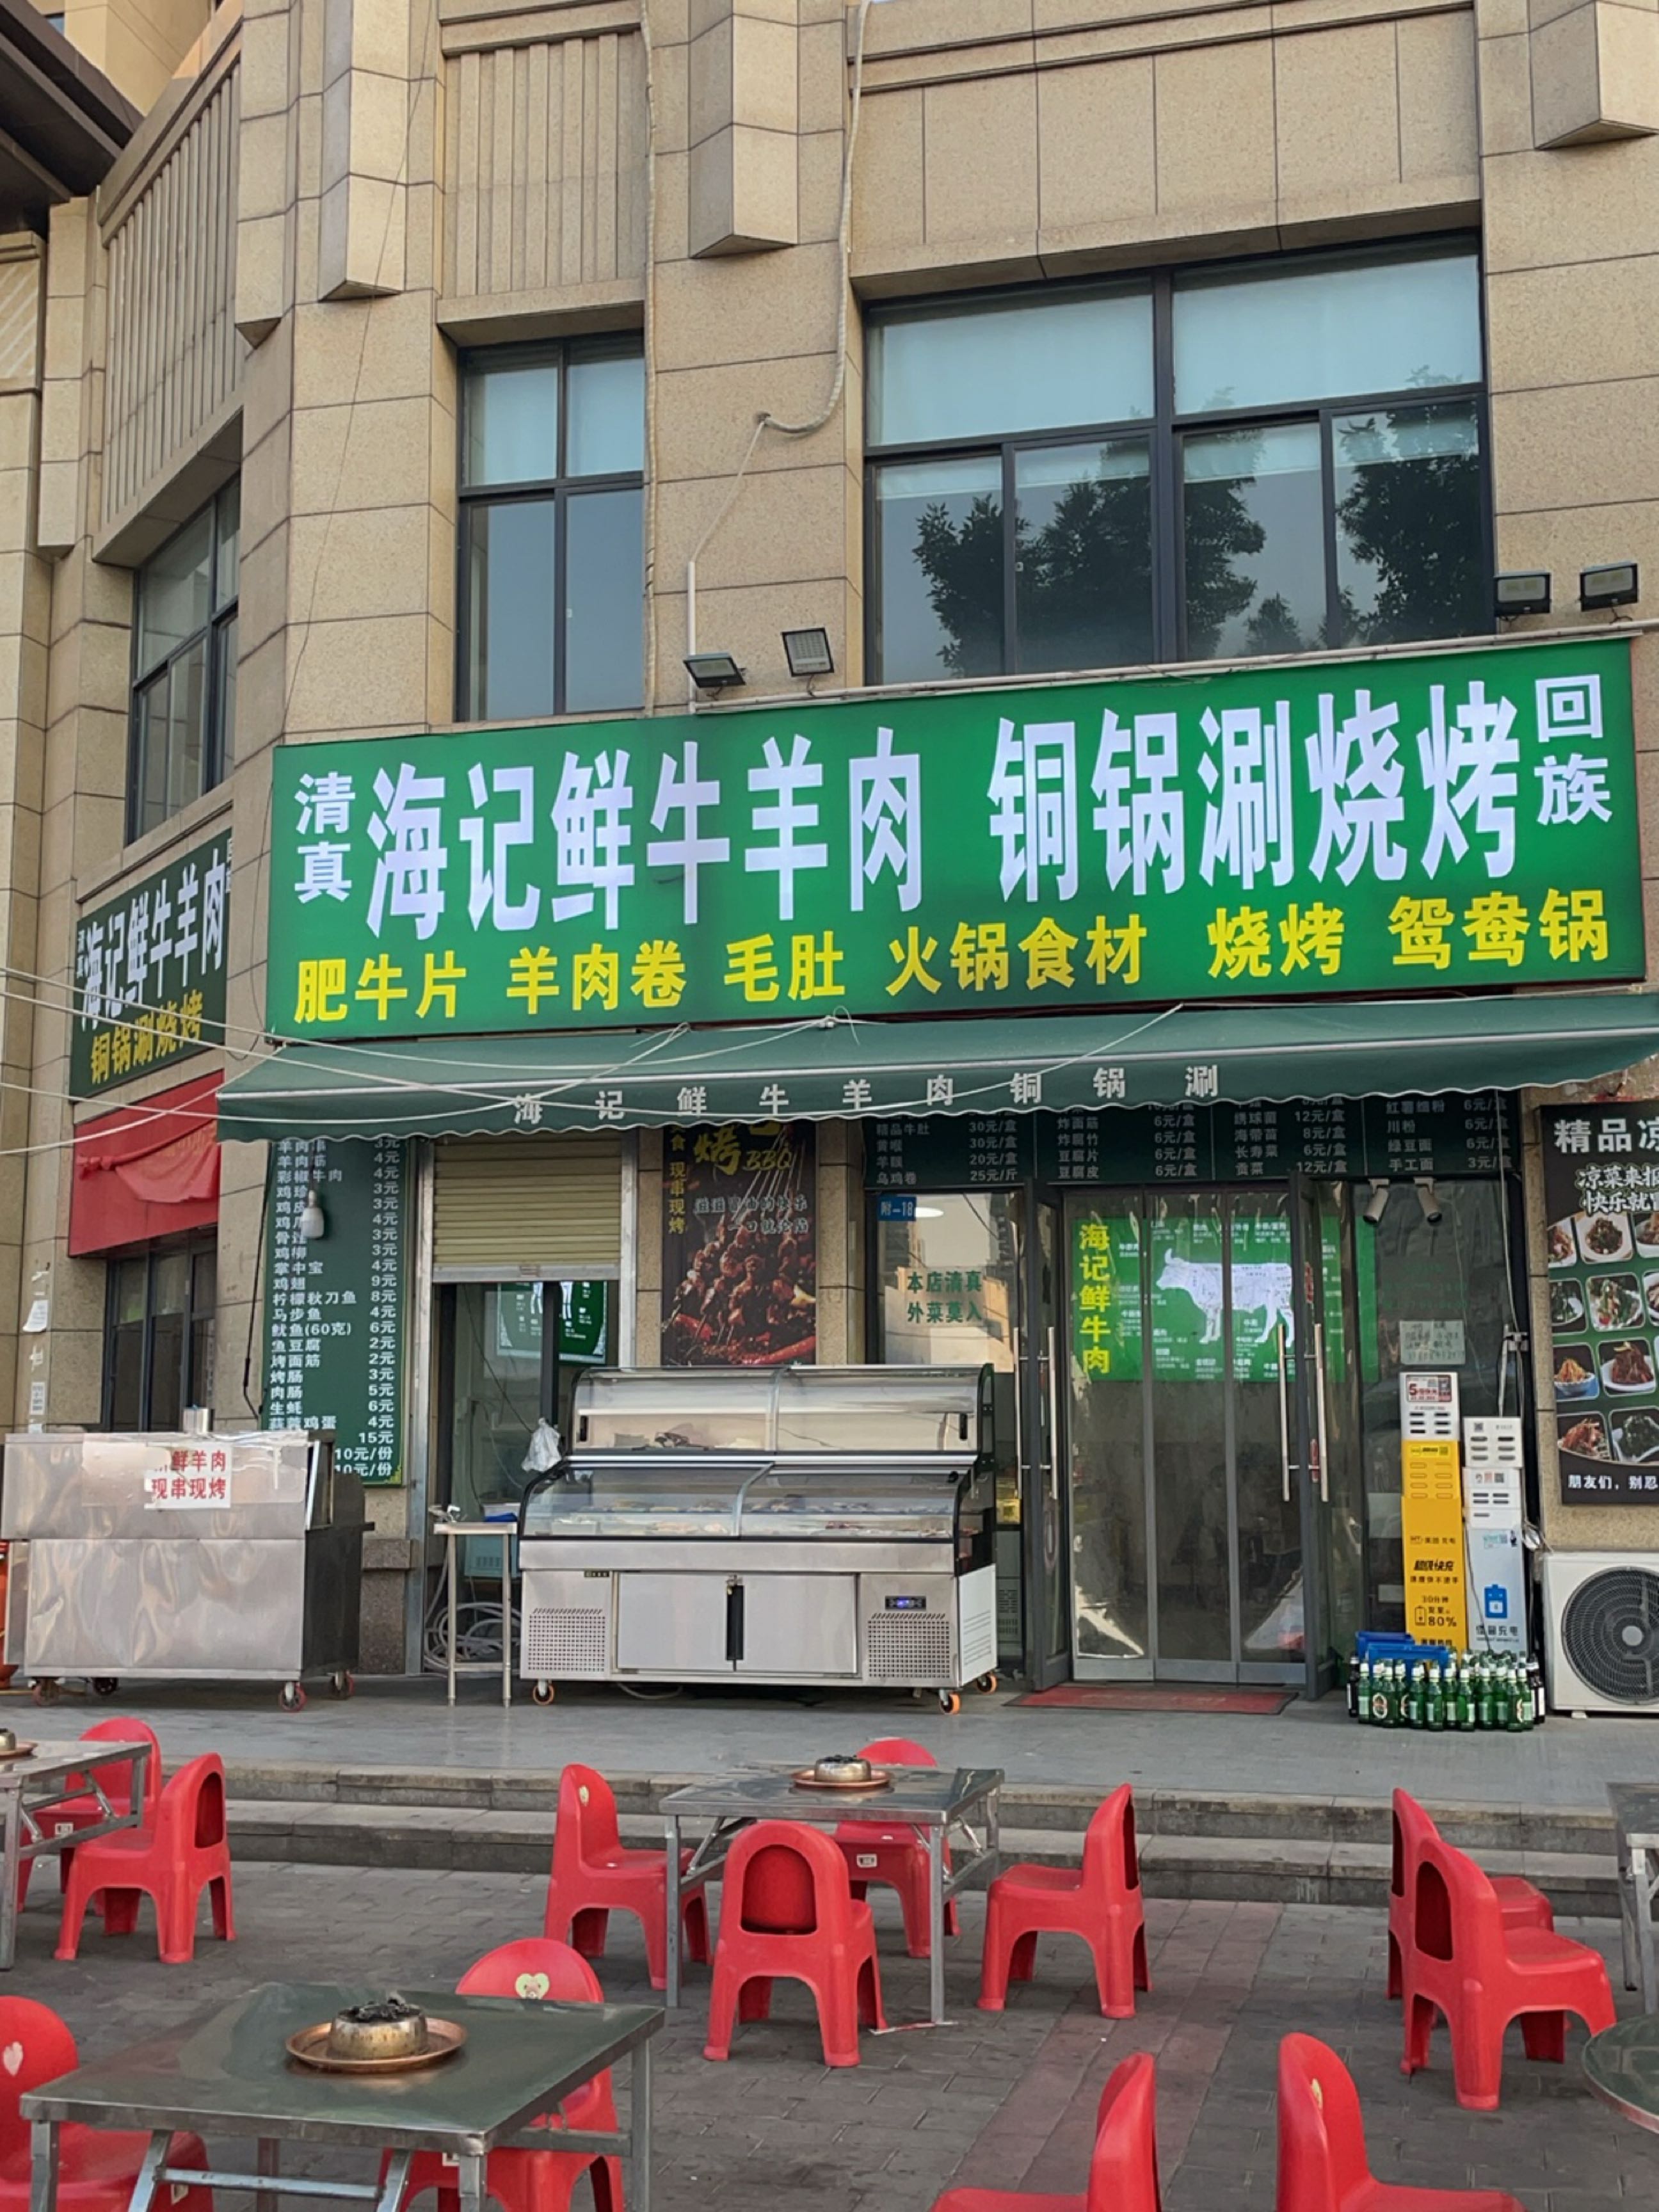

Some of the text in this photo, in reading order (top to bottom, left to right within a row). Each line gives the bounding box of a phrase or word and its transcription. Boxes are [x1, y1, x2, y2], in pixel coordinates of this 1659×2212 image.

[1534, 674, 1612, 826] 回族
[366, 682, 1520, 940] 海记鲜牛羊肉 铜锅涮烧烤
[293, 772, 356, 903] 清真
[83, 848, 225, 1031] 海记鲜牛羊肉
[293, 888, 1608, 1023] 肥牛片 羊肉卷 毛肚 火锅食材 烧烤 鸳鸯锅
[91, 989, 203, 1084] 铜锅涮烧烤
[514, 1064, 1217, 1125] 海记鲜牛羊肉铜锅涮
[1155, 1114, 1194, 1127] 6元/盒
[1295, 1109, 1345, 1122] 12元/盒
[969, 1119, 1016, 1134] 30元/盒
[1303, 1125, 1346, 1139] 8元/盒
[969, 1135, 1017, 1148] 30元/盒
[1155, 1130, 1195, 1144] 6元/盒
[1155, 1147, 1196, 1160] 6元/盒
[1304, 1142, 1346, 1157] 6元/盒
[374, 1151, 400, 1164] 4元
[969, 1151, 1018, 1165] 20元/盒
[1389, 1157, 1433, 1172] 手工面
[374, 1167, 399, 1179] 4元
[1155, 1163, 1197, 1177] 6元/盒
[1297, 1160, 1347, 1174] 12元/盒
[970, 1169, 1018, 1182] 25元/斤
[374, 1182, 399, 1194] 3元
[373, 1197, 399, 1210] 3元
[373, 1213, 398, 1225] 4元
[373, 1228, 398, 1240] 3元
[372, 1244, 397, 1256] 3元
[372, 1258, 397, 1272] 4元
[371, 1274, 397, 1286] 9元
[908, 1270, 982, 1293] 本店清真
[371, 1290, 396, 1303] 8元
[1079, 1224, 1110, 1374] 海记鲜牛肉
[370, 1305, 396, 1318] 4元
[908, 1301, 982, 1323] 外菜莫入
[369, 1321, 396, 1334] 6元
[369, 1336, 396, 1349] 2元
[369, 1352, 396, 1365] 2元
[369, 1367, 395, 1381] 3元
[271, 1383, 395, 1400] 肉肠 5元
[269, 1400, 394, 1415] 生蚝 6元
[368, 1415, 394, 1429] 4元
[358, 1431, 394, 1444] 15元
[155, 1450, 226, 1472] 鲜羊肉
[335, 1447, 392, 1461] 10元/份
[152, 1477, 226, 1499] 现串现烤
[1429, 1616, 1457, 1627] 80%
